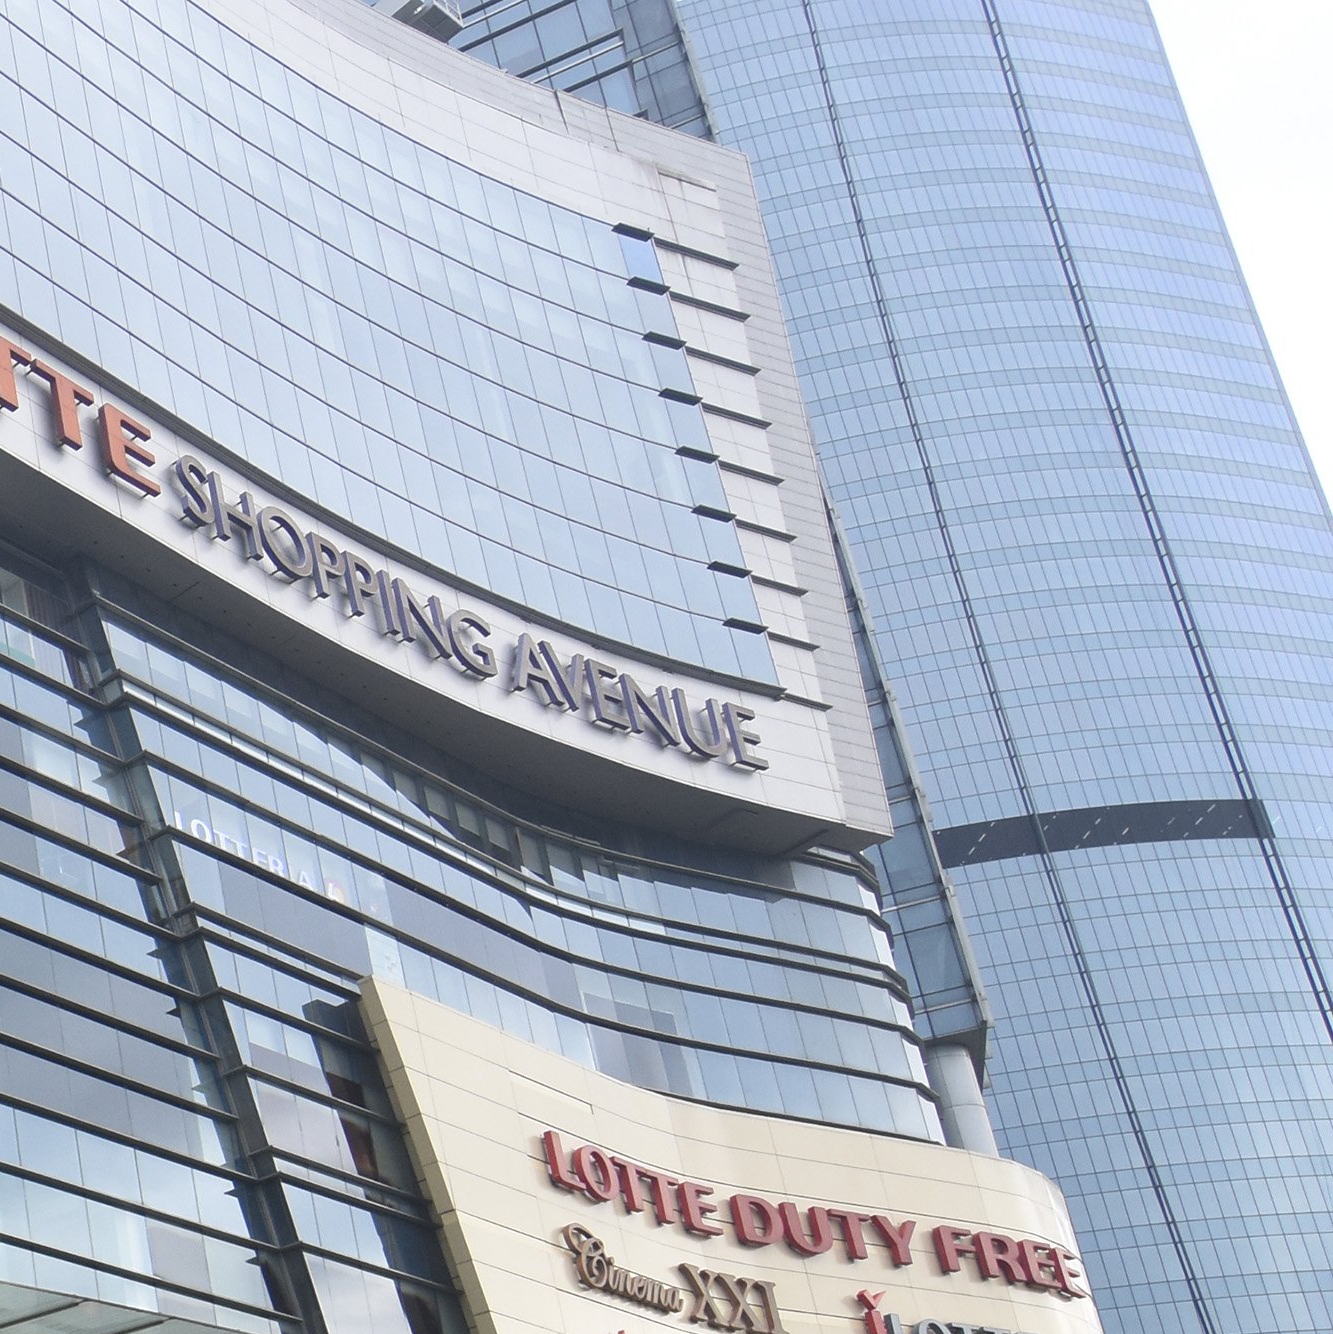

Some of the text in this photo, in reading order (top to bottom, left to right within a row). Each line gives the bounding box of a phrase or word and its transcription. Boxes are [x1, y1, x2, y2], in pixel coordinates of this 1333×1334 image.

[175, 454, 498, 679] SHOPPING
[513, 632, 770, 772] AVENUE
[543, 1130, 1085, 1299] LOTTE DUTY FREE
[562, 1222, 684, 1314] Cinema
